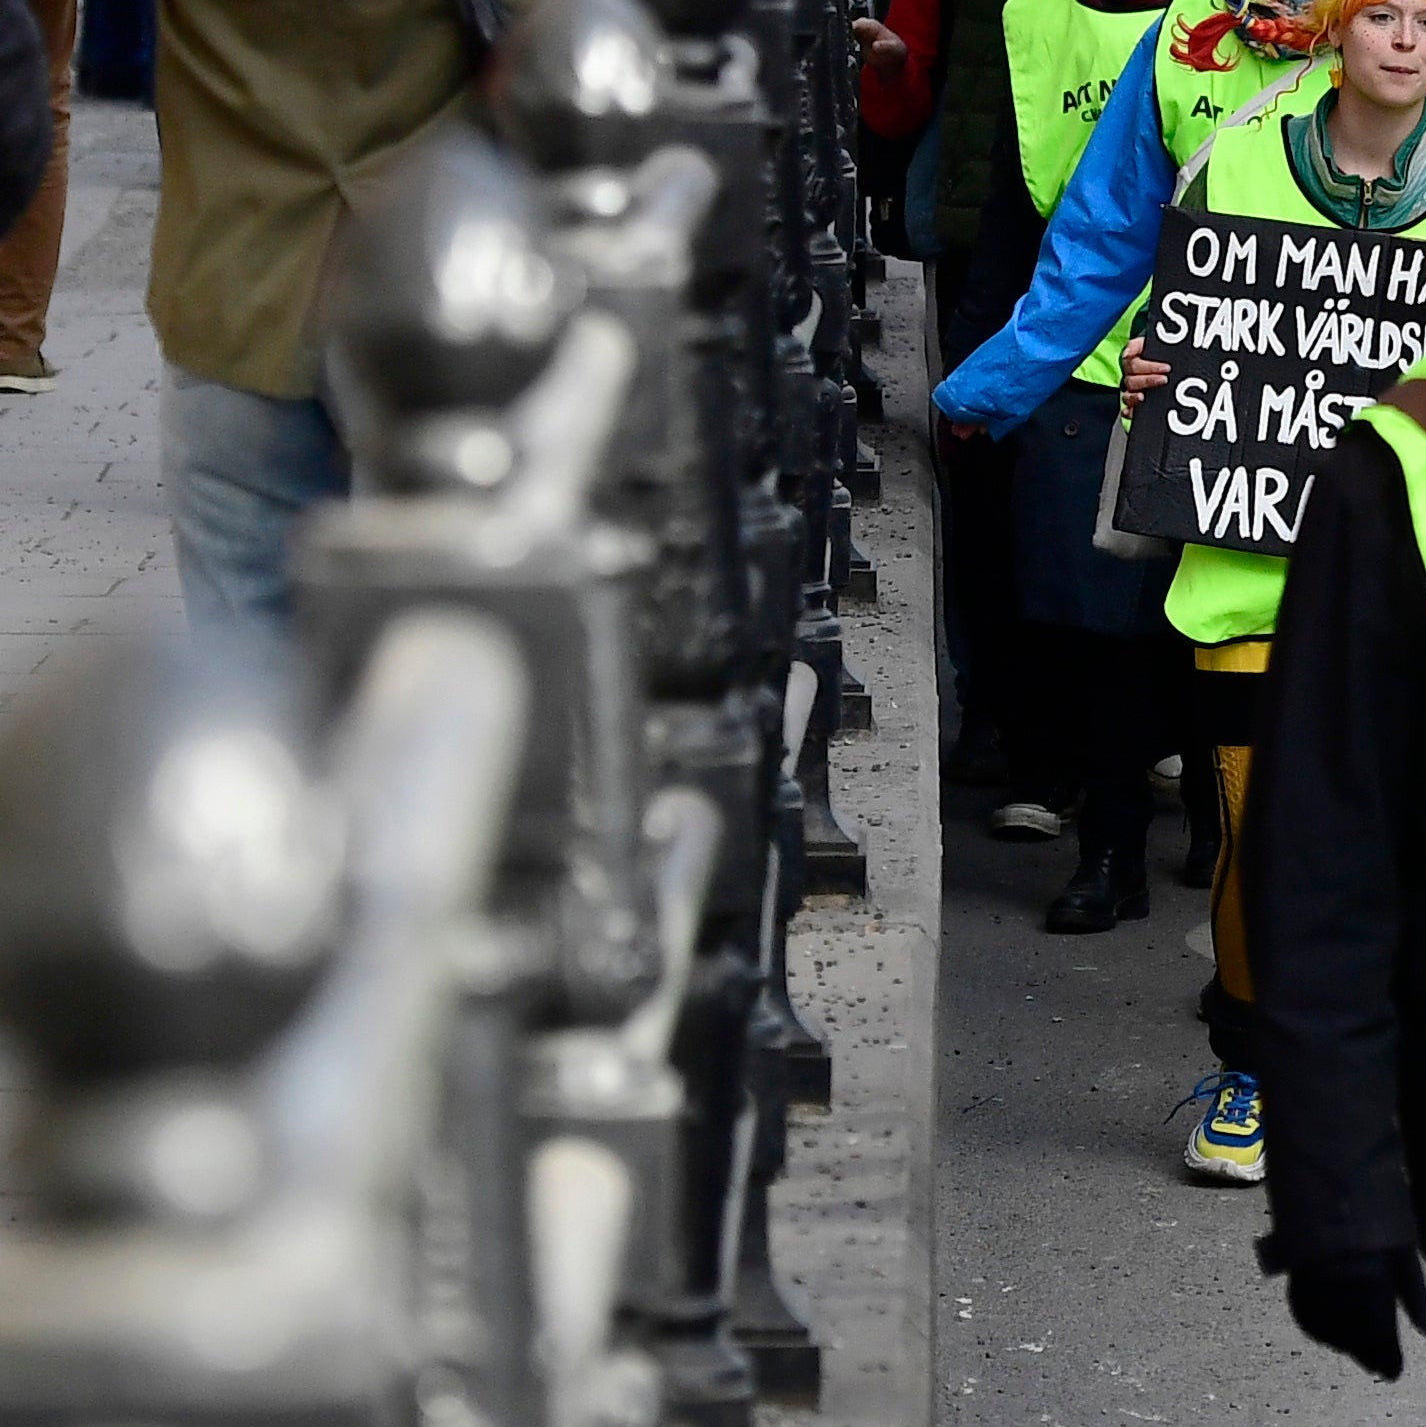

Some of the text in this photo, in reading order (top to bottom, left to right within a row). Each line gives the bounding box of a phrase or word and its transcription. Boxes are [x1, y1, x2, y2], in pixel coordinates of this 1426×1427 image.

[1186, 227, 1257, 286] OM
[1275, 234, 1381, 298] MAN
[1155, 290, 1286, 358] STARK
[1167, 360, 1240, 444] SÅ
